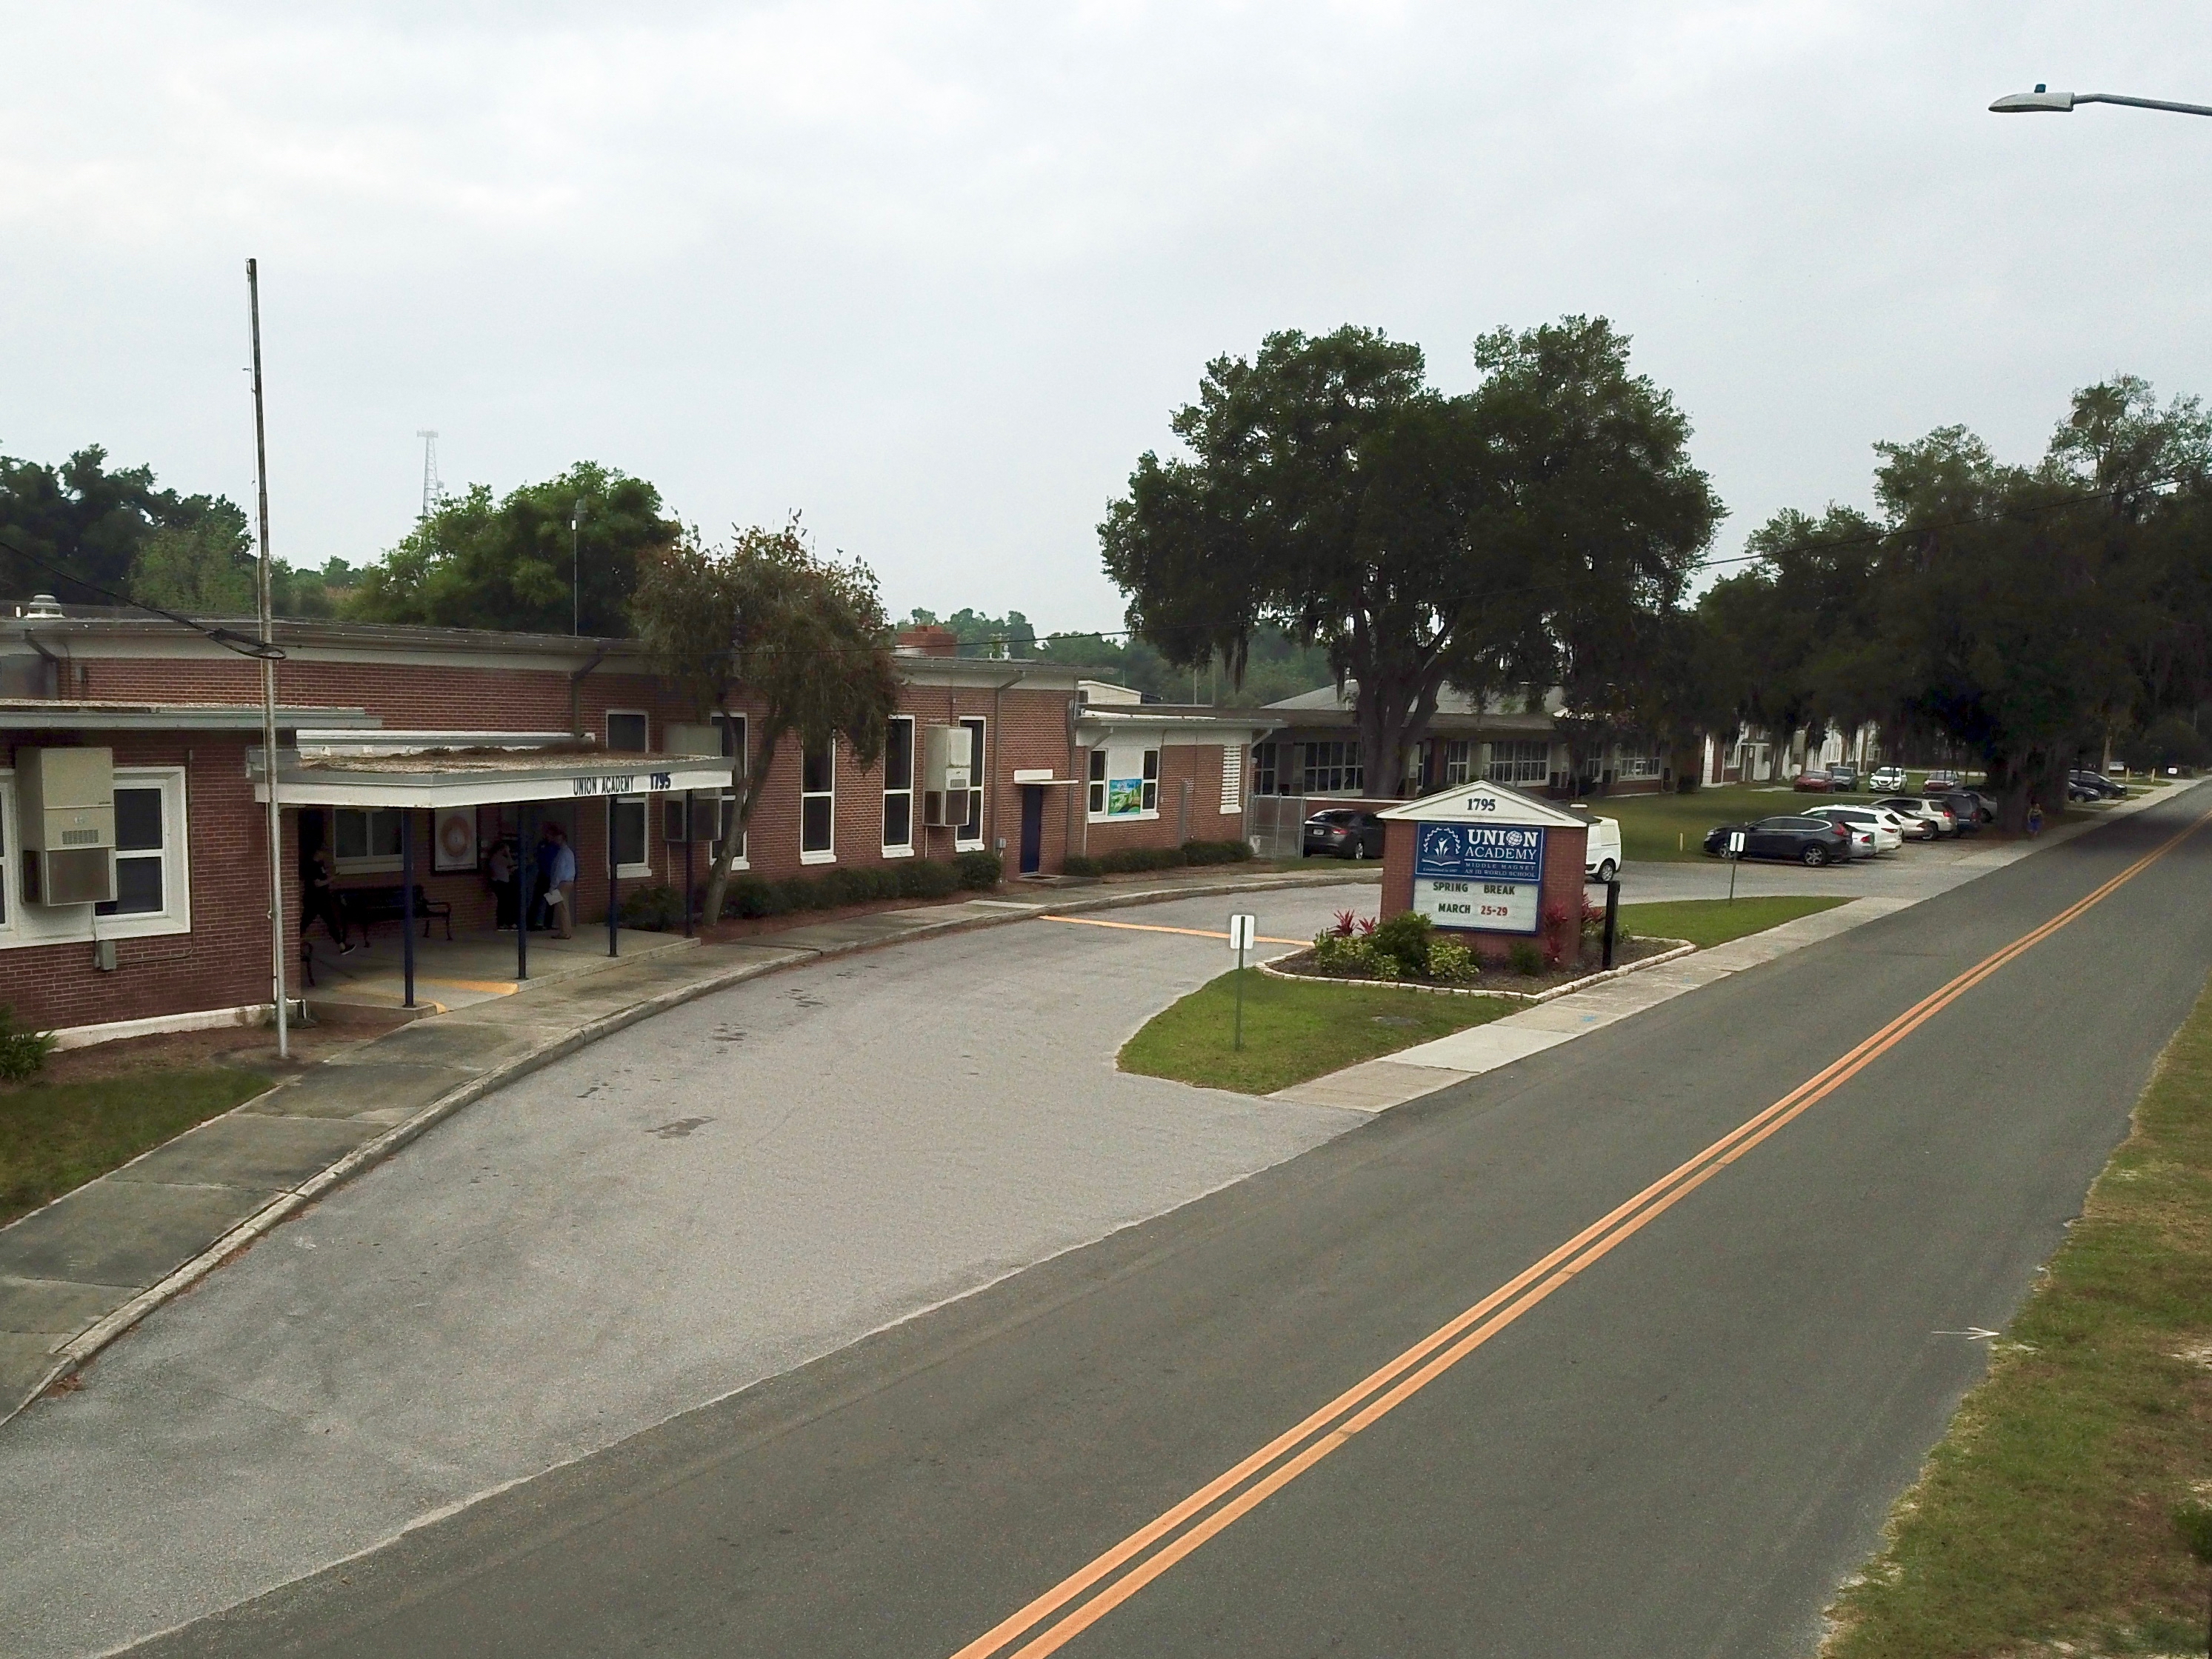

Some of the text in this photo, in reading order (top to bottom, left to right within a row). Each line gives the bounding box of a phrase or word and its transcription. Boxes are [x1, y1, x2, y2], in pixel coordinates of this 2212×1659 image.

[573, 771, 671, 796] UNION ACADEMY 1795
[1467, 798, 1496, 811] 1795
[1467, 829, 1539, 847] UNION
[1465, 846, 1537, 860] ACADEMY
[1433, 881, 1516, 895] SPRING BREAK
[1438, 903, 1508, 916] MARCH 25-29
